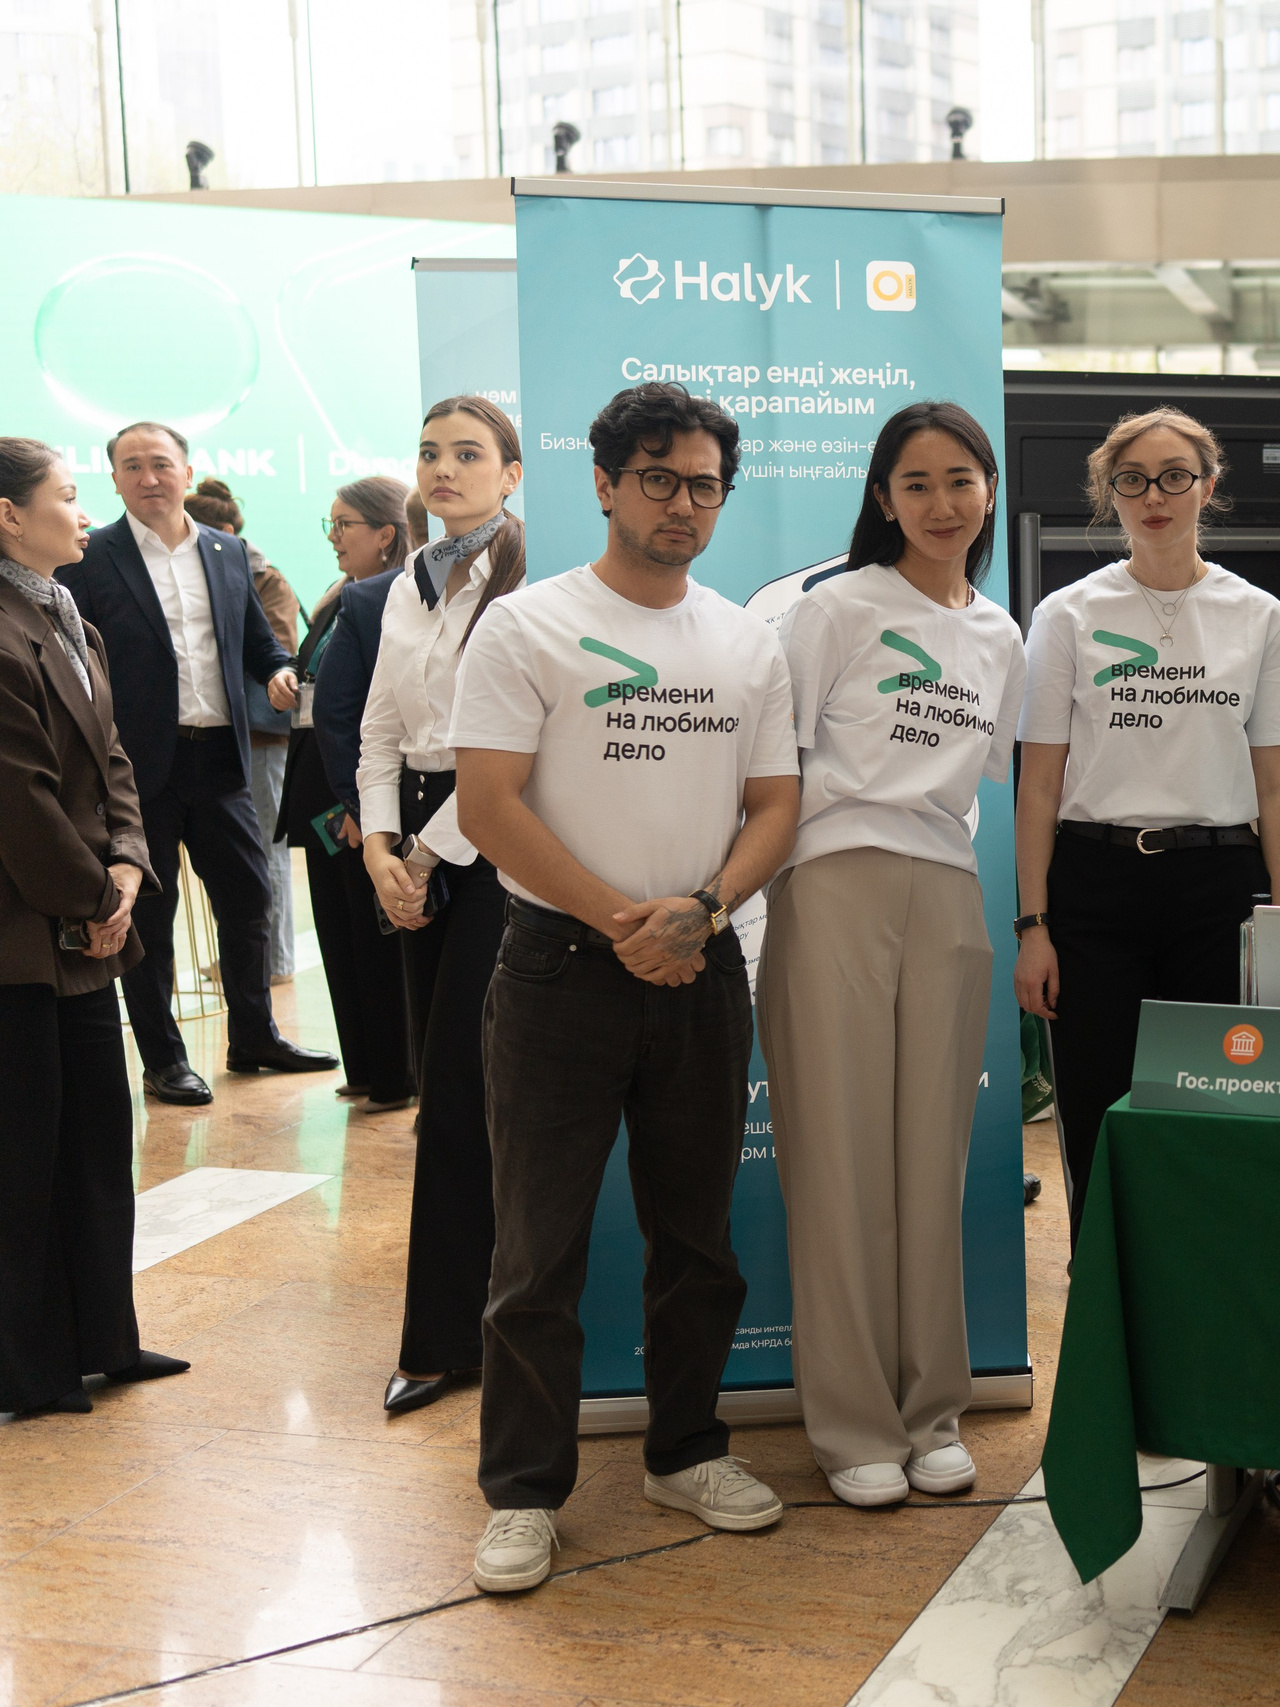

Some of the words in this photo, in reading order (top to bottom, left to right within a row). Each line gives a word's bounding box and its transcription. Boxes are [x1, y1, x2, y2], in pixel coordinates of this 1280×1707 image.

[674, 259, 813, 311] Halyk
[621, 357, 760, 388] Салықтар
[766, 361, 824, 388] енді
[830, 362, 916, 390] жеңіл,
[719, 392, 875, 418] қарапайым
[768, 439, 817, 453] және
[741, 461, 784, 482] үшін
[1111, 663, 1206, 682] времени
[607, 682, 714, 705] времени
[898, 672, 980, 706] времени
[1111, 687, 1136, 702] на
[1141, 686, 1240, 707] любимое
[606, 711, 636, 730] на
[896, 698, 921, 717] на
[924, 704, 995, 736] любимо
[1109, 712, 1163, 729] дело
[890, 724, 940, 748] дело
[603, 741, 666, 762] дело
